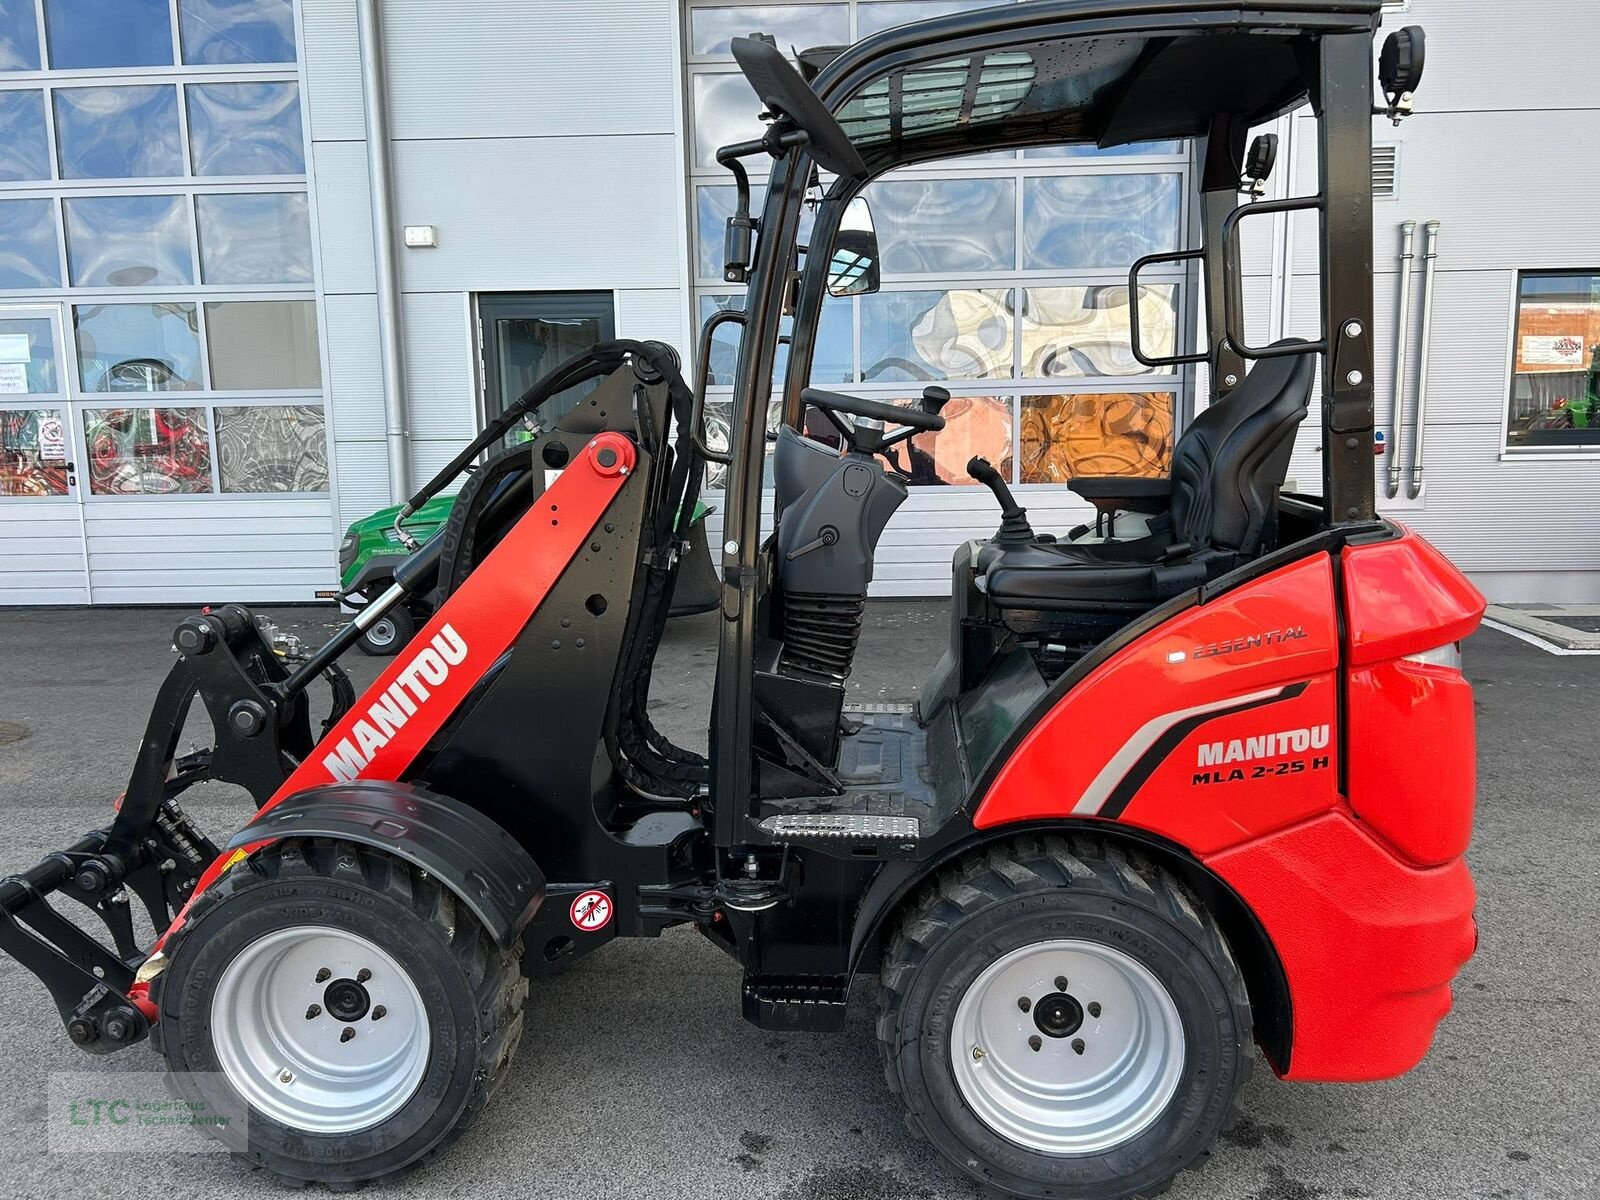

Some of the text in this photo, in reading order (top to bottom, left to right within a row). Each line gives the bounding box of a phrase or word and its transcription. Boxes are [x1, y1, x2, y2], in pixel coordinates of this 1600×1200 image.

[1192, 626, 1308, 659] ESSENTIAL
[322, 623, 468, 783] MANITOU
[1197, 724, 1330, 767] MANITOU
[1192, 756, 1329, 786] MLA 2-25 H
